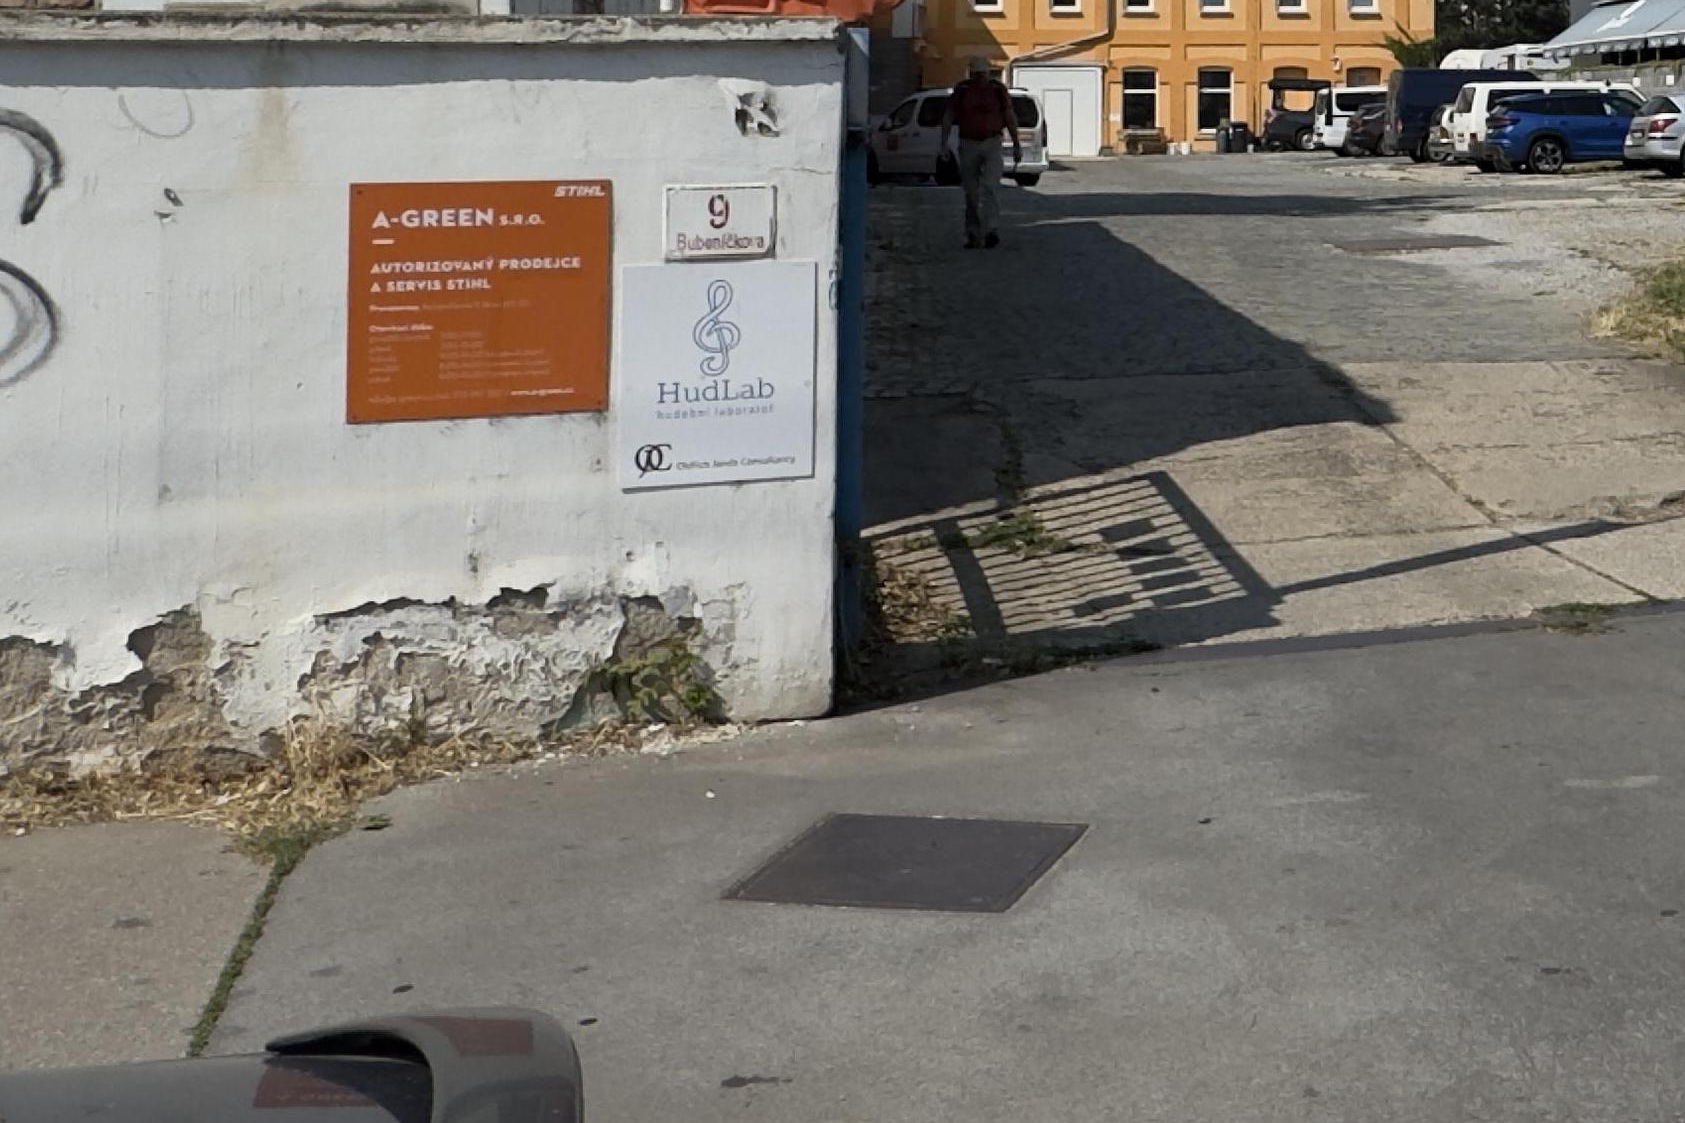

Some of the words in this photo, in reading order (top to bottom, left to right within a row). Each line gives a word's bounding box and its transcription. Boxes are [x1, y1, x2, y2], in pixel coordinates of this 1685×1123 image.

[554, 185, 606, 198] STIHL
[372, 207, 495, 229] A-GREEN
[707, 193, 731, 229] 9
[370, 255, 495, 275] AUTORIZOVANÝ
[500, 256, 582, 270] PRODEJCE
[370, 281, 383, 293] A
[386, 279, 443, 293] SERVIS
[447, 278, 492, 291] STIHL
[657, 376, 776, 404] HudLab
